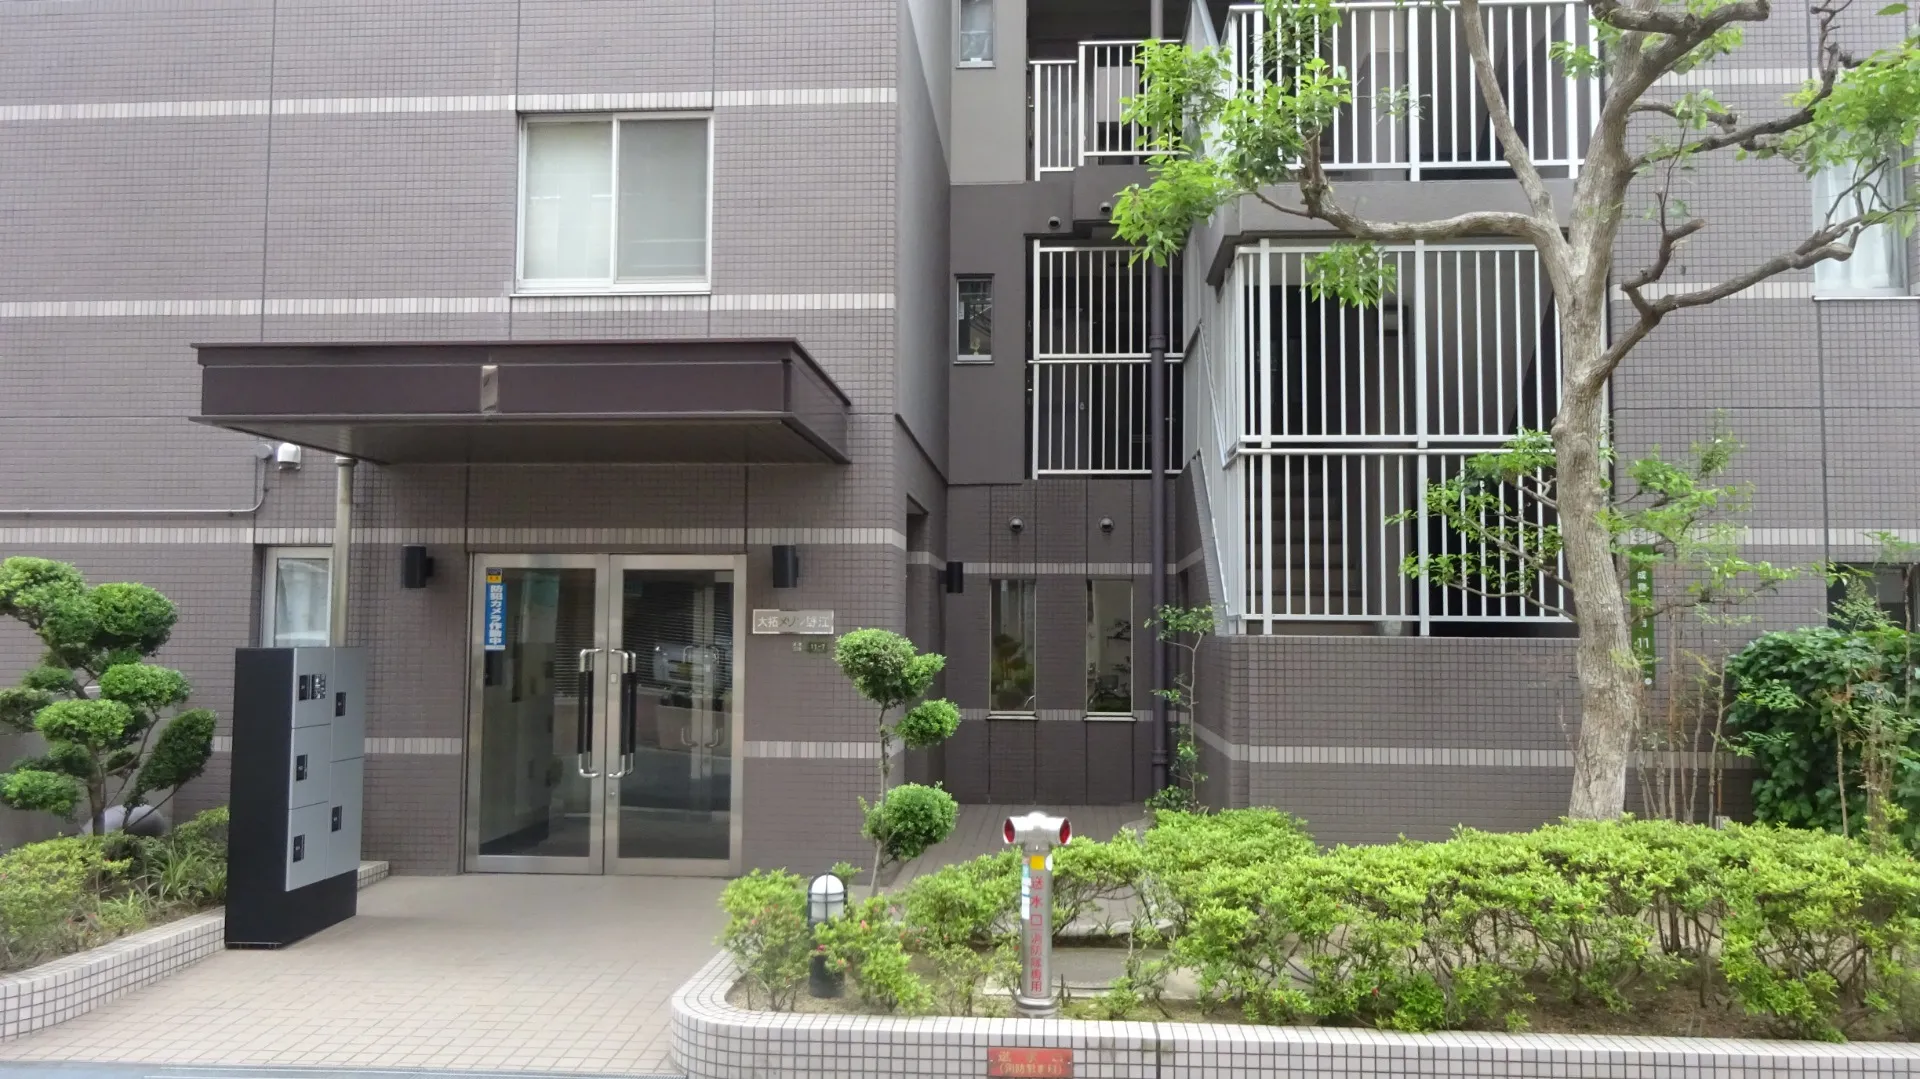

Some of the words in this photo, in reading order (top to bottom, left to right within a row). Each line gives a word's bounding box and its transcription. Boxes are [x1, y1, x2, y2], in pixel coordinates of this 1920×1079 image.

[488, 584, 504, 645] 防犯カメラ作動中
[1637, 637, 1649, 649] 11
